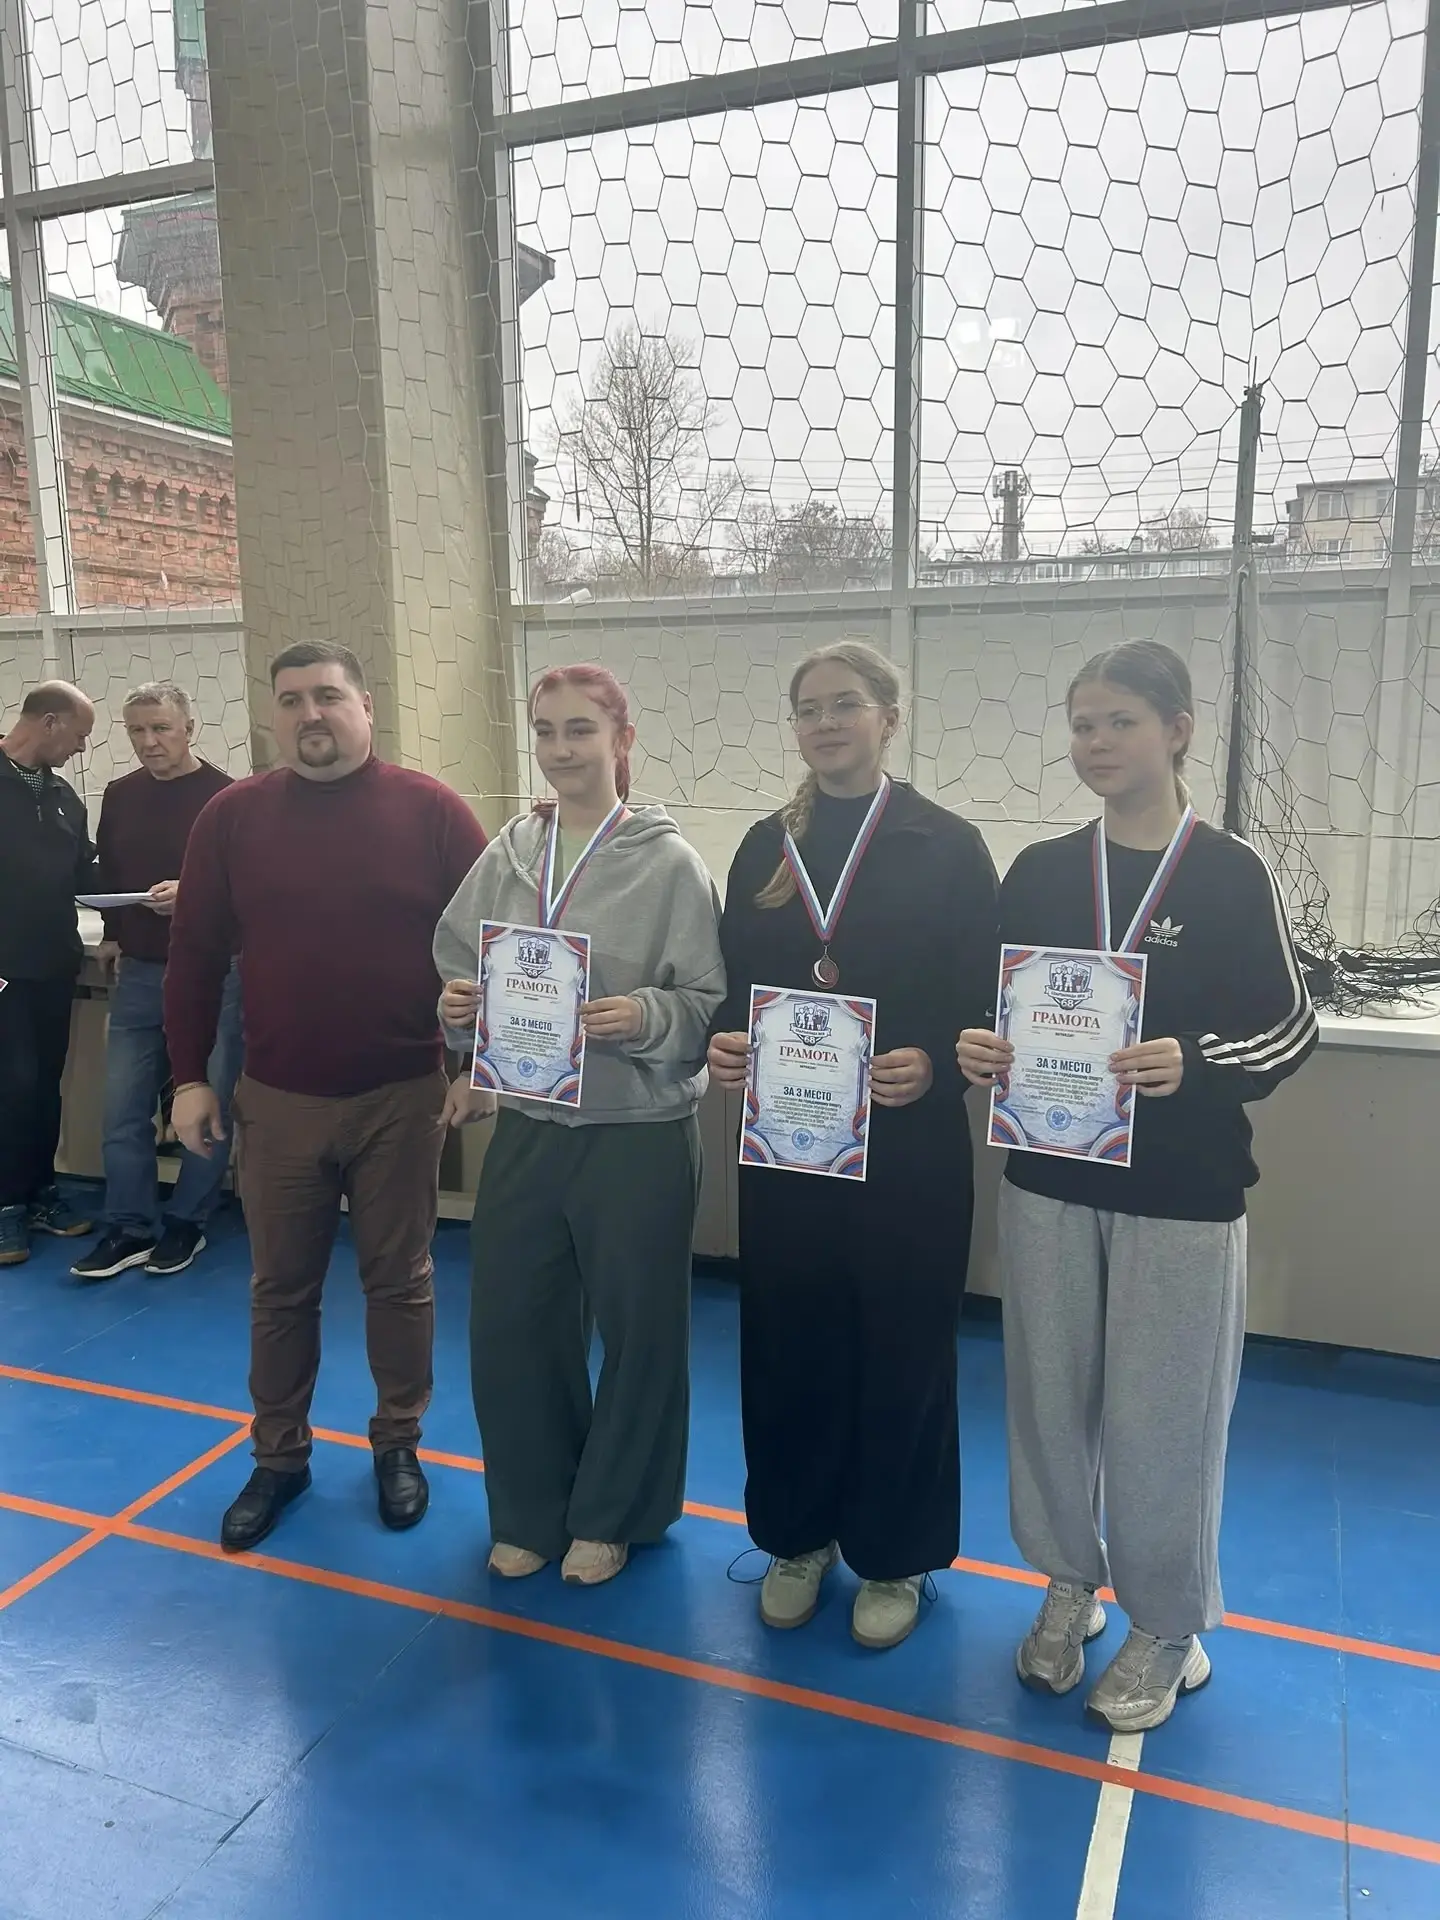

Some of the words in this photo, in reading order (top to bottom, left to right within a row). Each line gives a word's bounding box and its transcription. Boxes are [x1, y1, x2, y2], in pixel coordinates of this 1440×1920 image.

[1144, 935, 1178, 947] adidas
[528, 969, 538, 977] 68
[506, 978, 559, 995] ГРАМОТА
[1061, 999, 1074, 1008] 68
[510, 1016, 520, 1027] ЗА
[521, 1018, 527, 1027] 3
[528, 1019, 552, 1031] МЕСТО
[1032, 1011, 1101, 1029] ГРАМОТА
[804, 1035, 816, 1044] 68
[779, 1045, 840, 1063] ГРАМОТА
[1036, 1057, 1049, 1069] ЗА
[1051, 1059, 1058, 1070] 3
[1060, 1060, 1092, 1074] МЕСТО
[783, 1086, 794, 1096] ЗА
[796, 1088, 802, 1097] 3
[804, 1089, 832, 1101] МЕСТО
